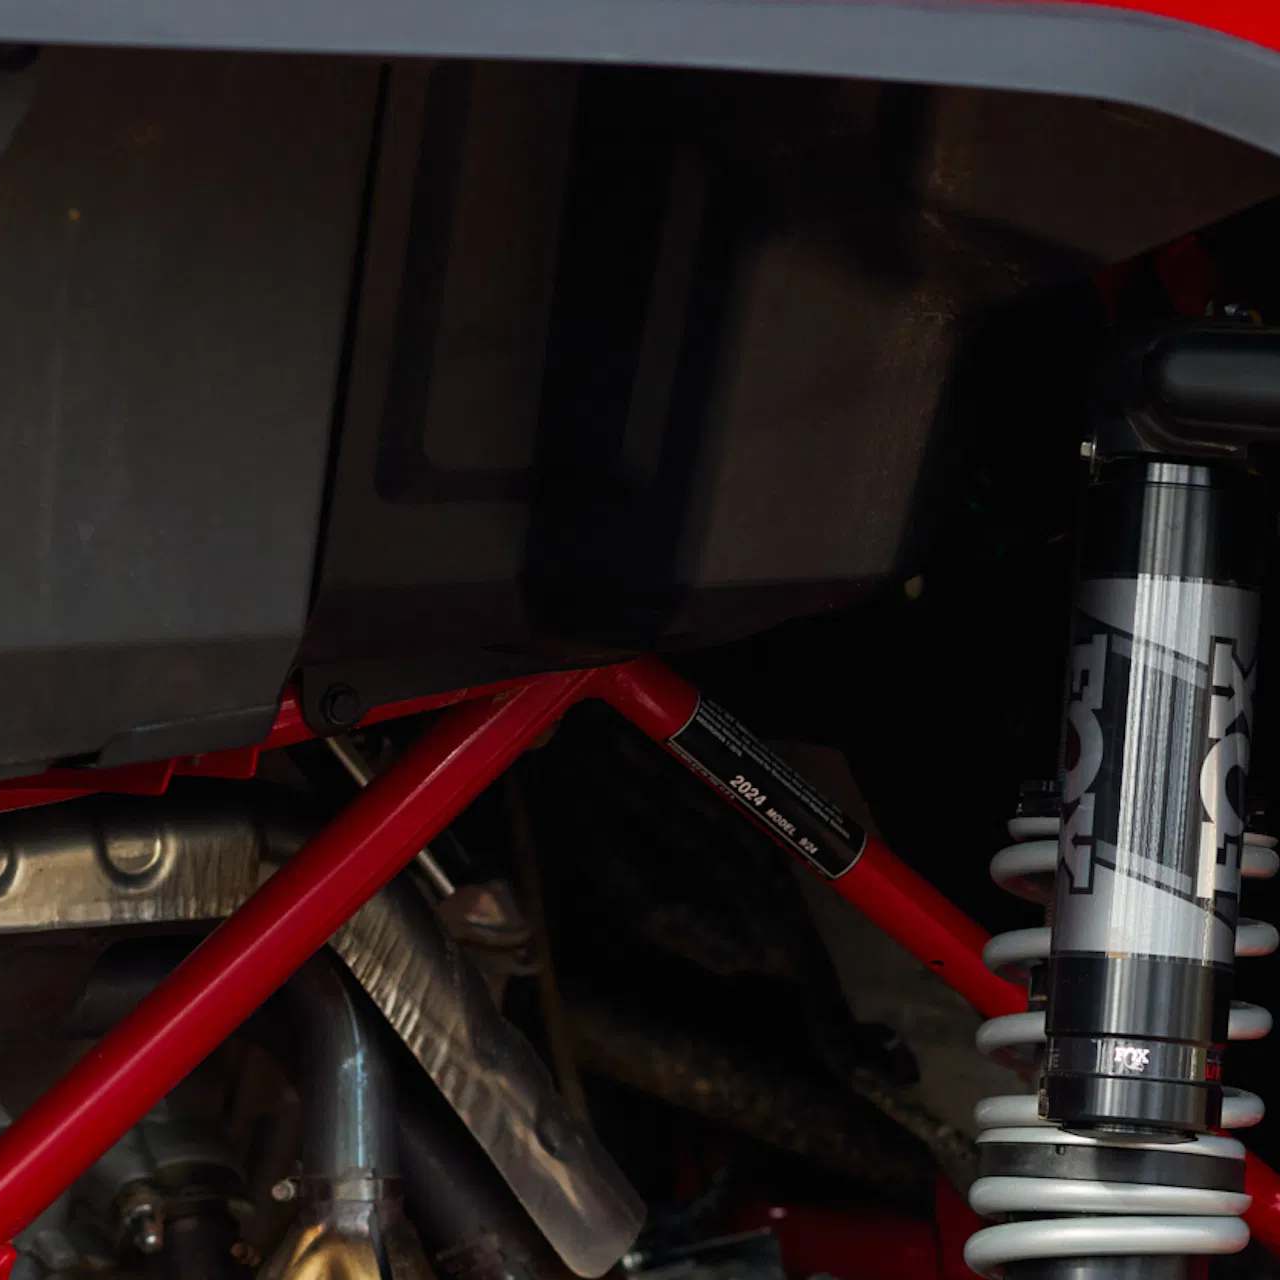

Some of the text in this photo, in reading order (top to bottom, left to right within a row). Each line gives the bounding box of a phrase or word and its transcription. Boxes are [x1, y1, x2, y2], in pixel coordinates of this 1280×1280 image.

[729, 774, 768, 807] 2024
[765, 807, 797, 837] MODEL
[1114, 1046, 1150, 1072] FOX
